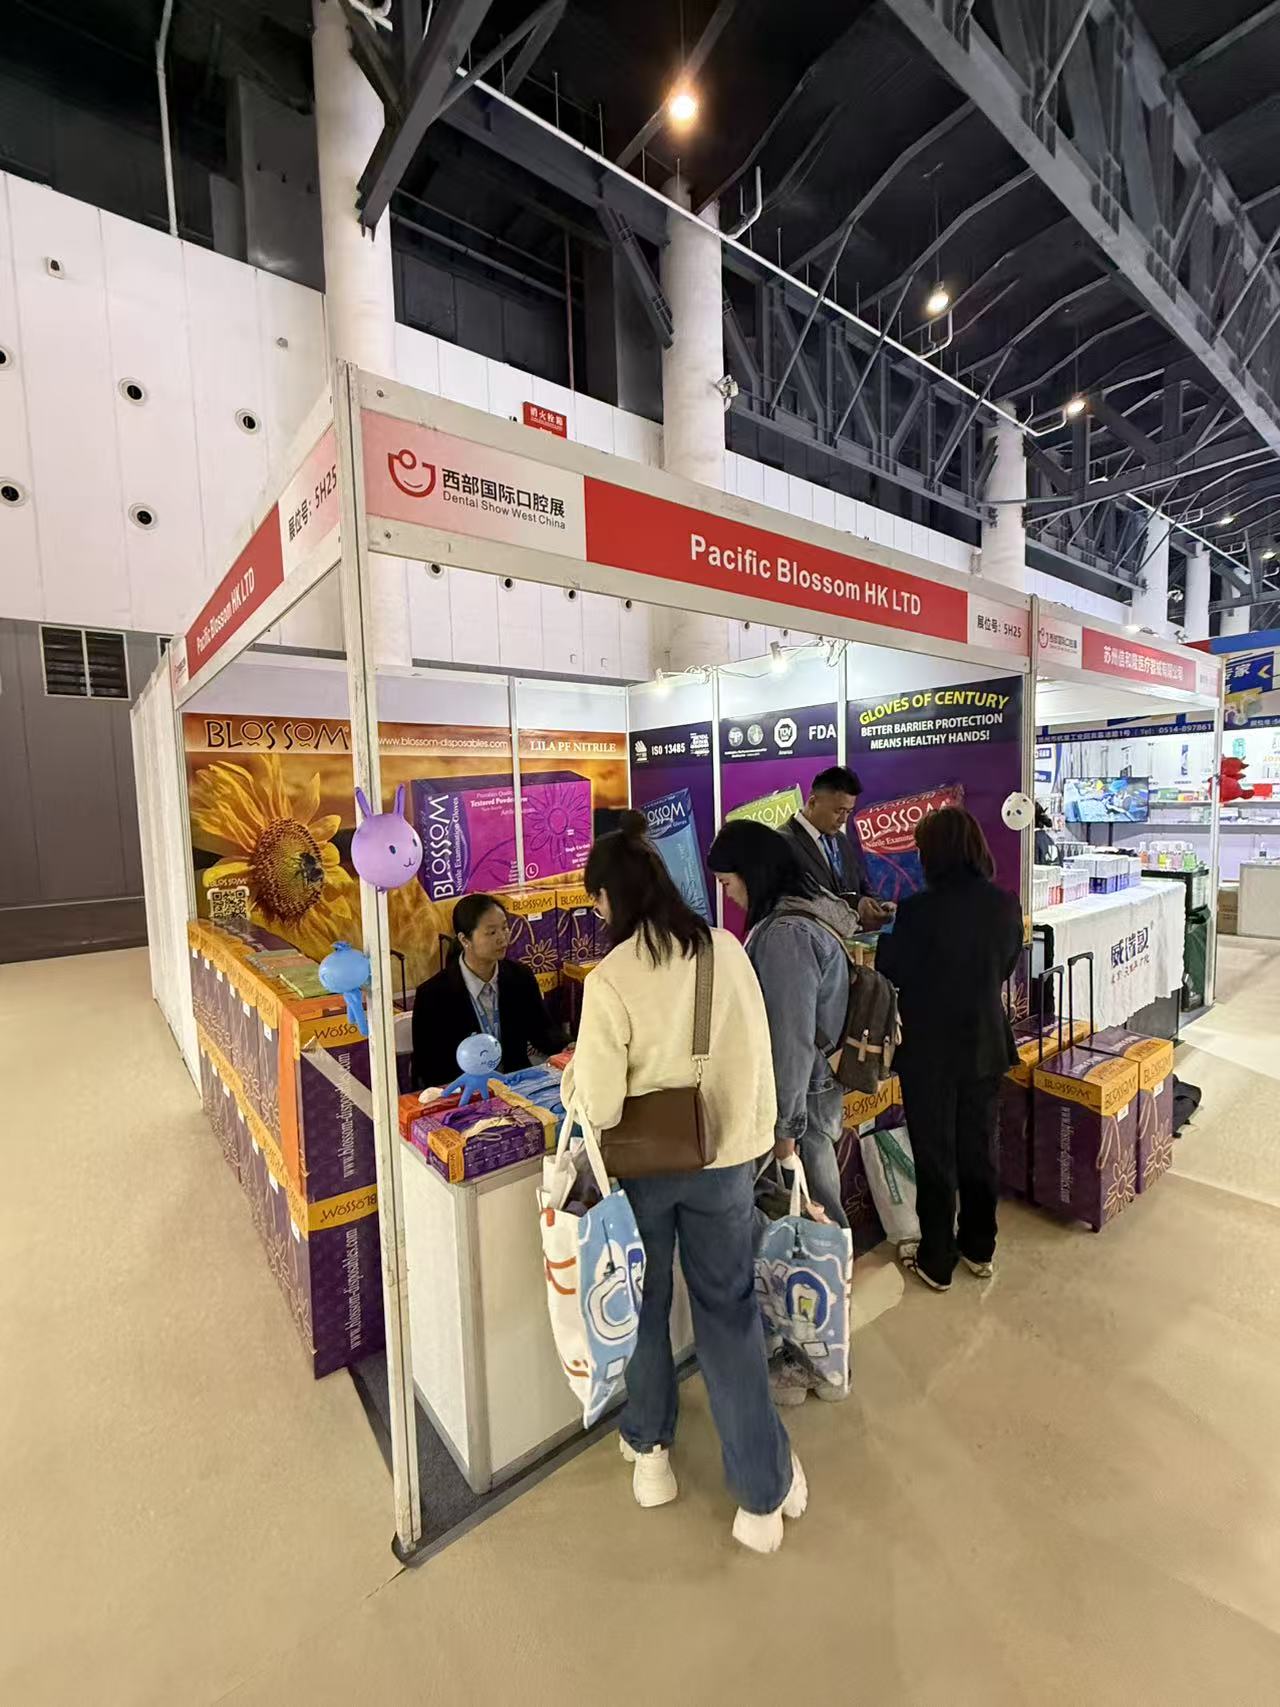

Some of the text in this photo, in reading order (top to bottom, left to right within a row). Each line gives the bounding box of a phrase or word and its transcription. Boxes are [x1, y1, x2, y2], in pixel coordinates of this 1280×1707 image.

[441, 468, 565, 518] 西部国际口腔展
[442, 490, 566, 530] Dental Show West China
[690, 533, 921, 616] Pacific Blossom HK LTD
[209, 601, 233, 644] Blossom
[230, 584, 242, 614] HK
[240, 567, 256, 601] LTD
[858, 691, 1010, 726] GLOVES OF CENTURY
[204, 720, 349, 750] BLOSSOM
[808, 723, 837, 741] FDA
[861, 713, 1003, 737] BETTER BARRIER PROTECTION
[870, 729, 990, 750] MEANS HEALTHY HANDS!
[530, 740, 617, 753] LILA PF NITRILE
[651, 744, 663, 756] ISO
[664, 742, 686, 754] 13485
[647, 801, 686, 825] OSSOM
[429, 794, 454, 898] BLOSSOM
[512, 896, 553, 911] BLOSSOM
[842, 1088, 889, 1120] BLOSSOM
[1044, 1078, 1092, 1101] BLOSSOM
[345, 1228, 363, 1350] www.blossom-disposables.com
